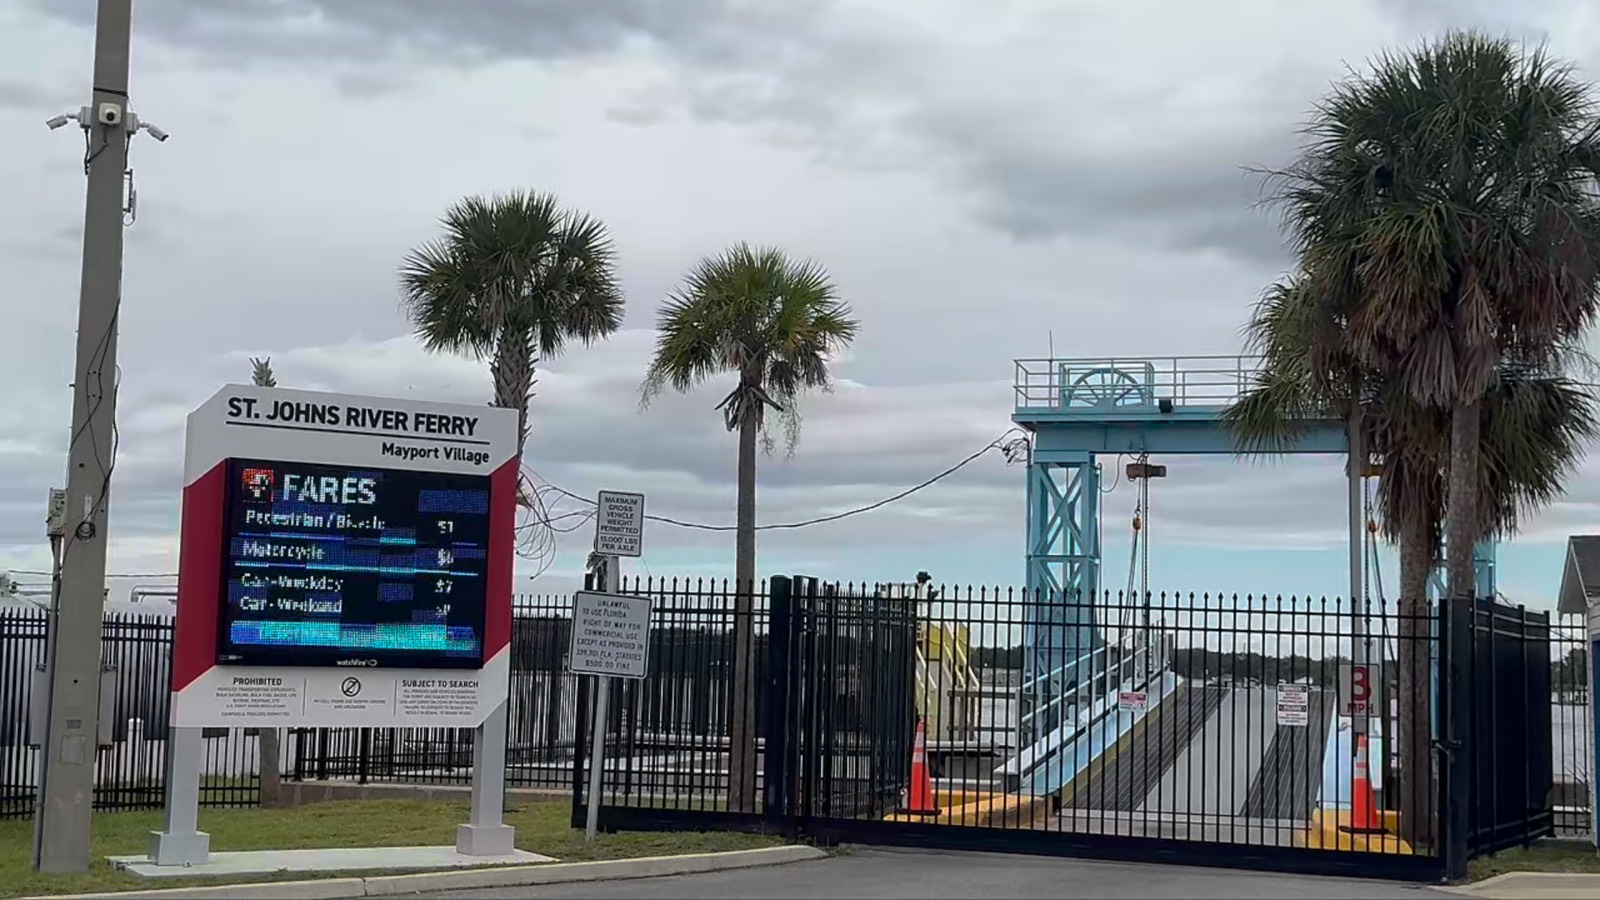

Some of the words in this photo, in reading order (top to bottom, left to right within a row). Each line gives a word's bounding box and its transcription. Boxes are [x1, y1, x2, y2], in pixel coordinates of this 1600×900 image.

[227, 397, 260, 419] ST.
[265, 401, 340, 425] JOHNS
[346, 407, 408, 431] RIVER
[414, 412, 479, 436] FERRY
[381, 442, 440, 460] Mayport
[443, 446, 490, 465] Village
[283, 474, 376, 504] FARES
[605, 497, 637, 505] MAXIMUM
[608, 504, 633, 512] GROSS
[606, 511, 634, 519] VEHICLE
[600, 525, 638, 534] PERMITTED
[597, 600, 630, 609] UNLAWFUL
[603, 609, 627, 618] FLORIDA
[603, 620, 612, 628] OF
[614, 621, 627, 629] WAY
[584, 628, 623, 639] COMMERCIAL
[577, 637, 598, 646] EXCEPT
[608, 640, 636, 650] PROVIDED
[616, 662, 630, 670] FINE
[233, 677, 282, 686] PROHIBITED
[402, 679, 435, 687] SUBJECT
[437, 680, 447, 688] TO
[449, 680, 478, 688] SEARCH
[1352, 666, 1371, 701] 3
[1347, 703, 1374, 714] MPH
